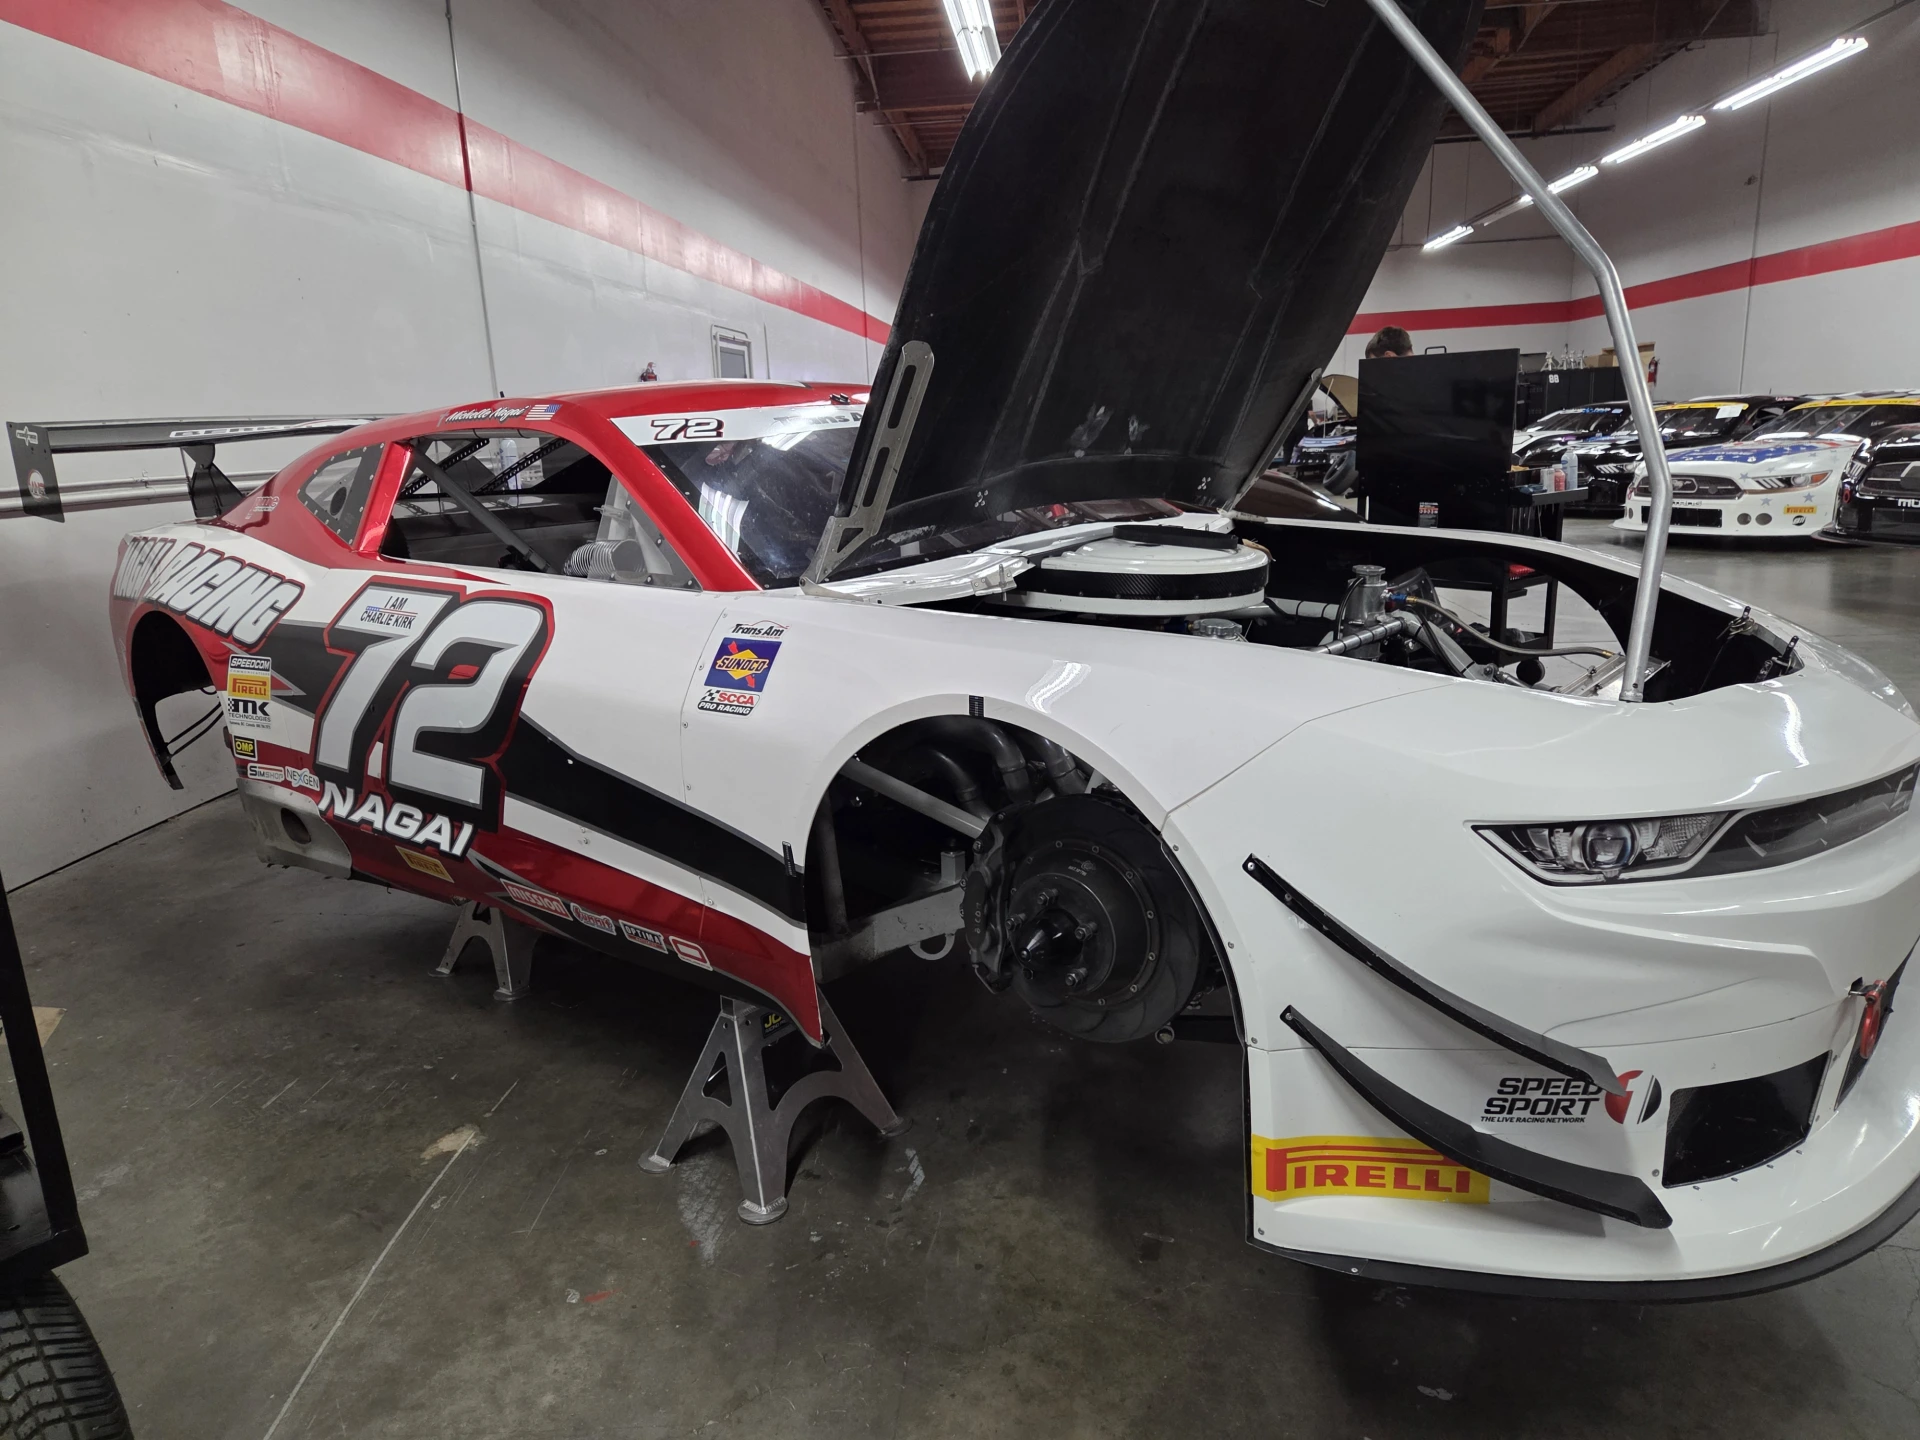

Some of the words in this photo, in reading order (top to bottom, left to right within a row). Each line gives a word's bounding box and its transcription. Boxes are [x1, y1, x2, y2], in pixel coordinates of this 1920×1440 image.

[651, 417, 724, 442] 72
[142, 542, 302, 646] RACING
[384, 596, 392, 609] I
[389, 597, 408, 611] AM
[360, 610, 394, 626] CHARLIE
[392, 616, 415, 629] KIRK
[731, 623, 764, 637] Trans
[761, 626, 784, 637] Am
[230, 657, 271, 671] SPEEDCOM
[717, 656, 767, 672] SUNOCO
[232, 678, 267, 696] PIRELLI
[315, 586, 543, 810] 72
[717, 692, 754, 706] SCCA
[698, 701, 716, 710] PRO
[716, 704, 751, 714] RACING
[228, 712, 271, 722] TECHNOLOGIES
[235, 741, 254, 752] OMP
[318, 780, 473, 857] NAGAI
[625, 925, 662, 945] OPTIMA
[1483, 1098, 1601, 1115] SPORT
[1265, 1145, 1471, 1194] PIRELLI
